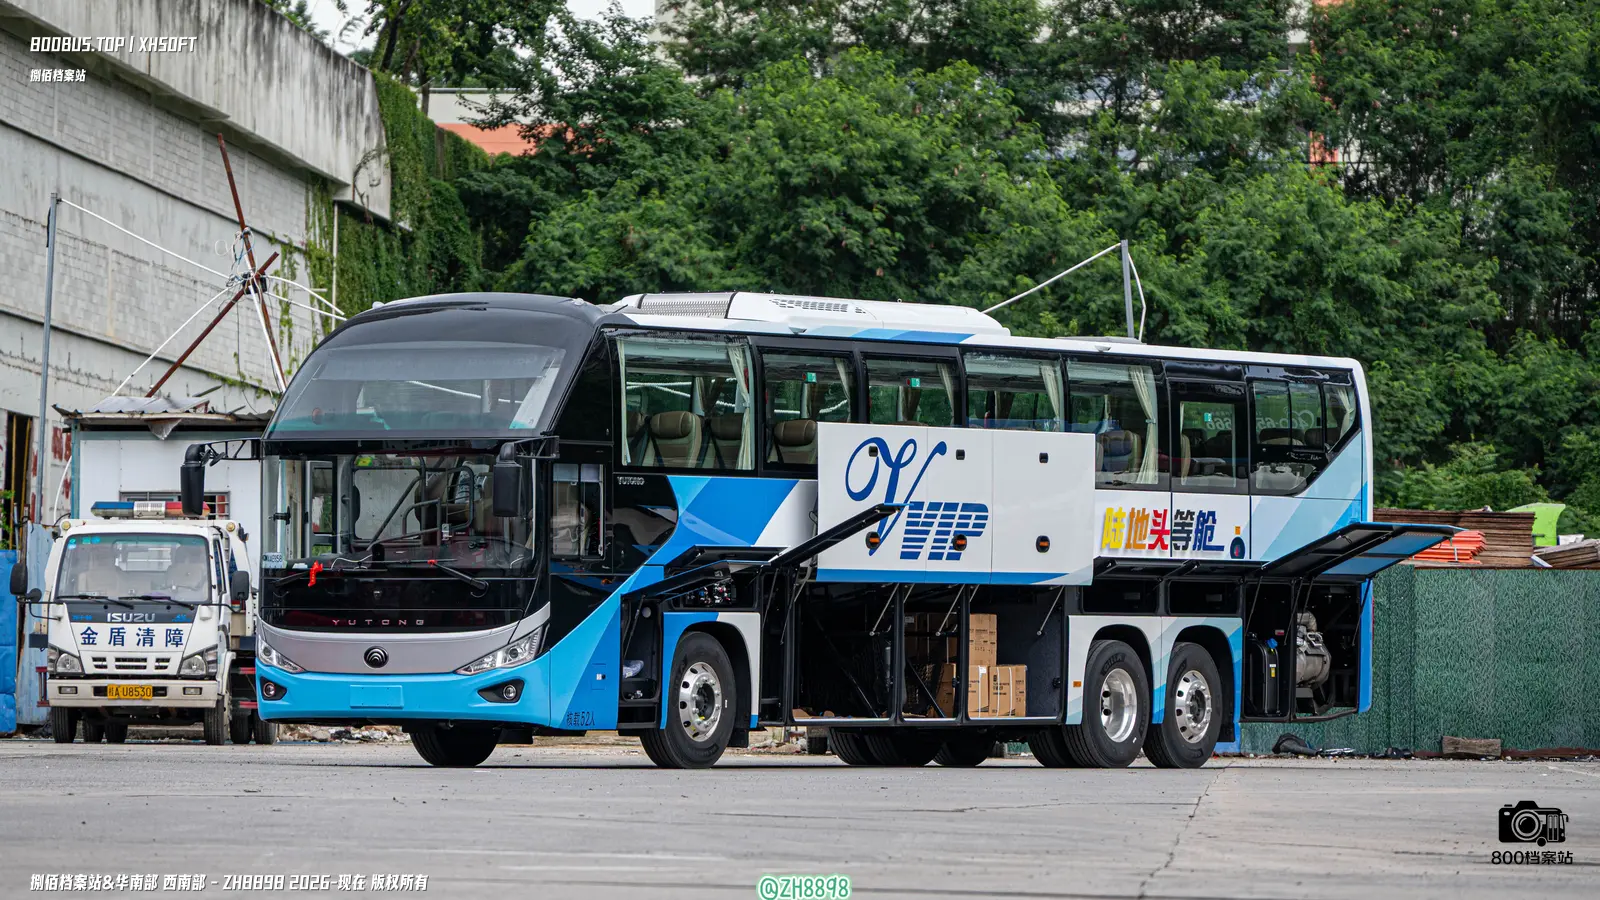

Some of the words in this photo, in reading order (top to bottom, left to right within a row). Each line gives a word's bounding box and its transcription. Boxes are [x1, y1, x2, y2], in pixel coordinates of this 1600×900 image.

[1101, 506, 1225, 552] 陆地头等舱
[107, 612, 156, 623] ISUZU
[80, 626, 184, 648] 金盾清障
